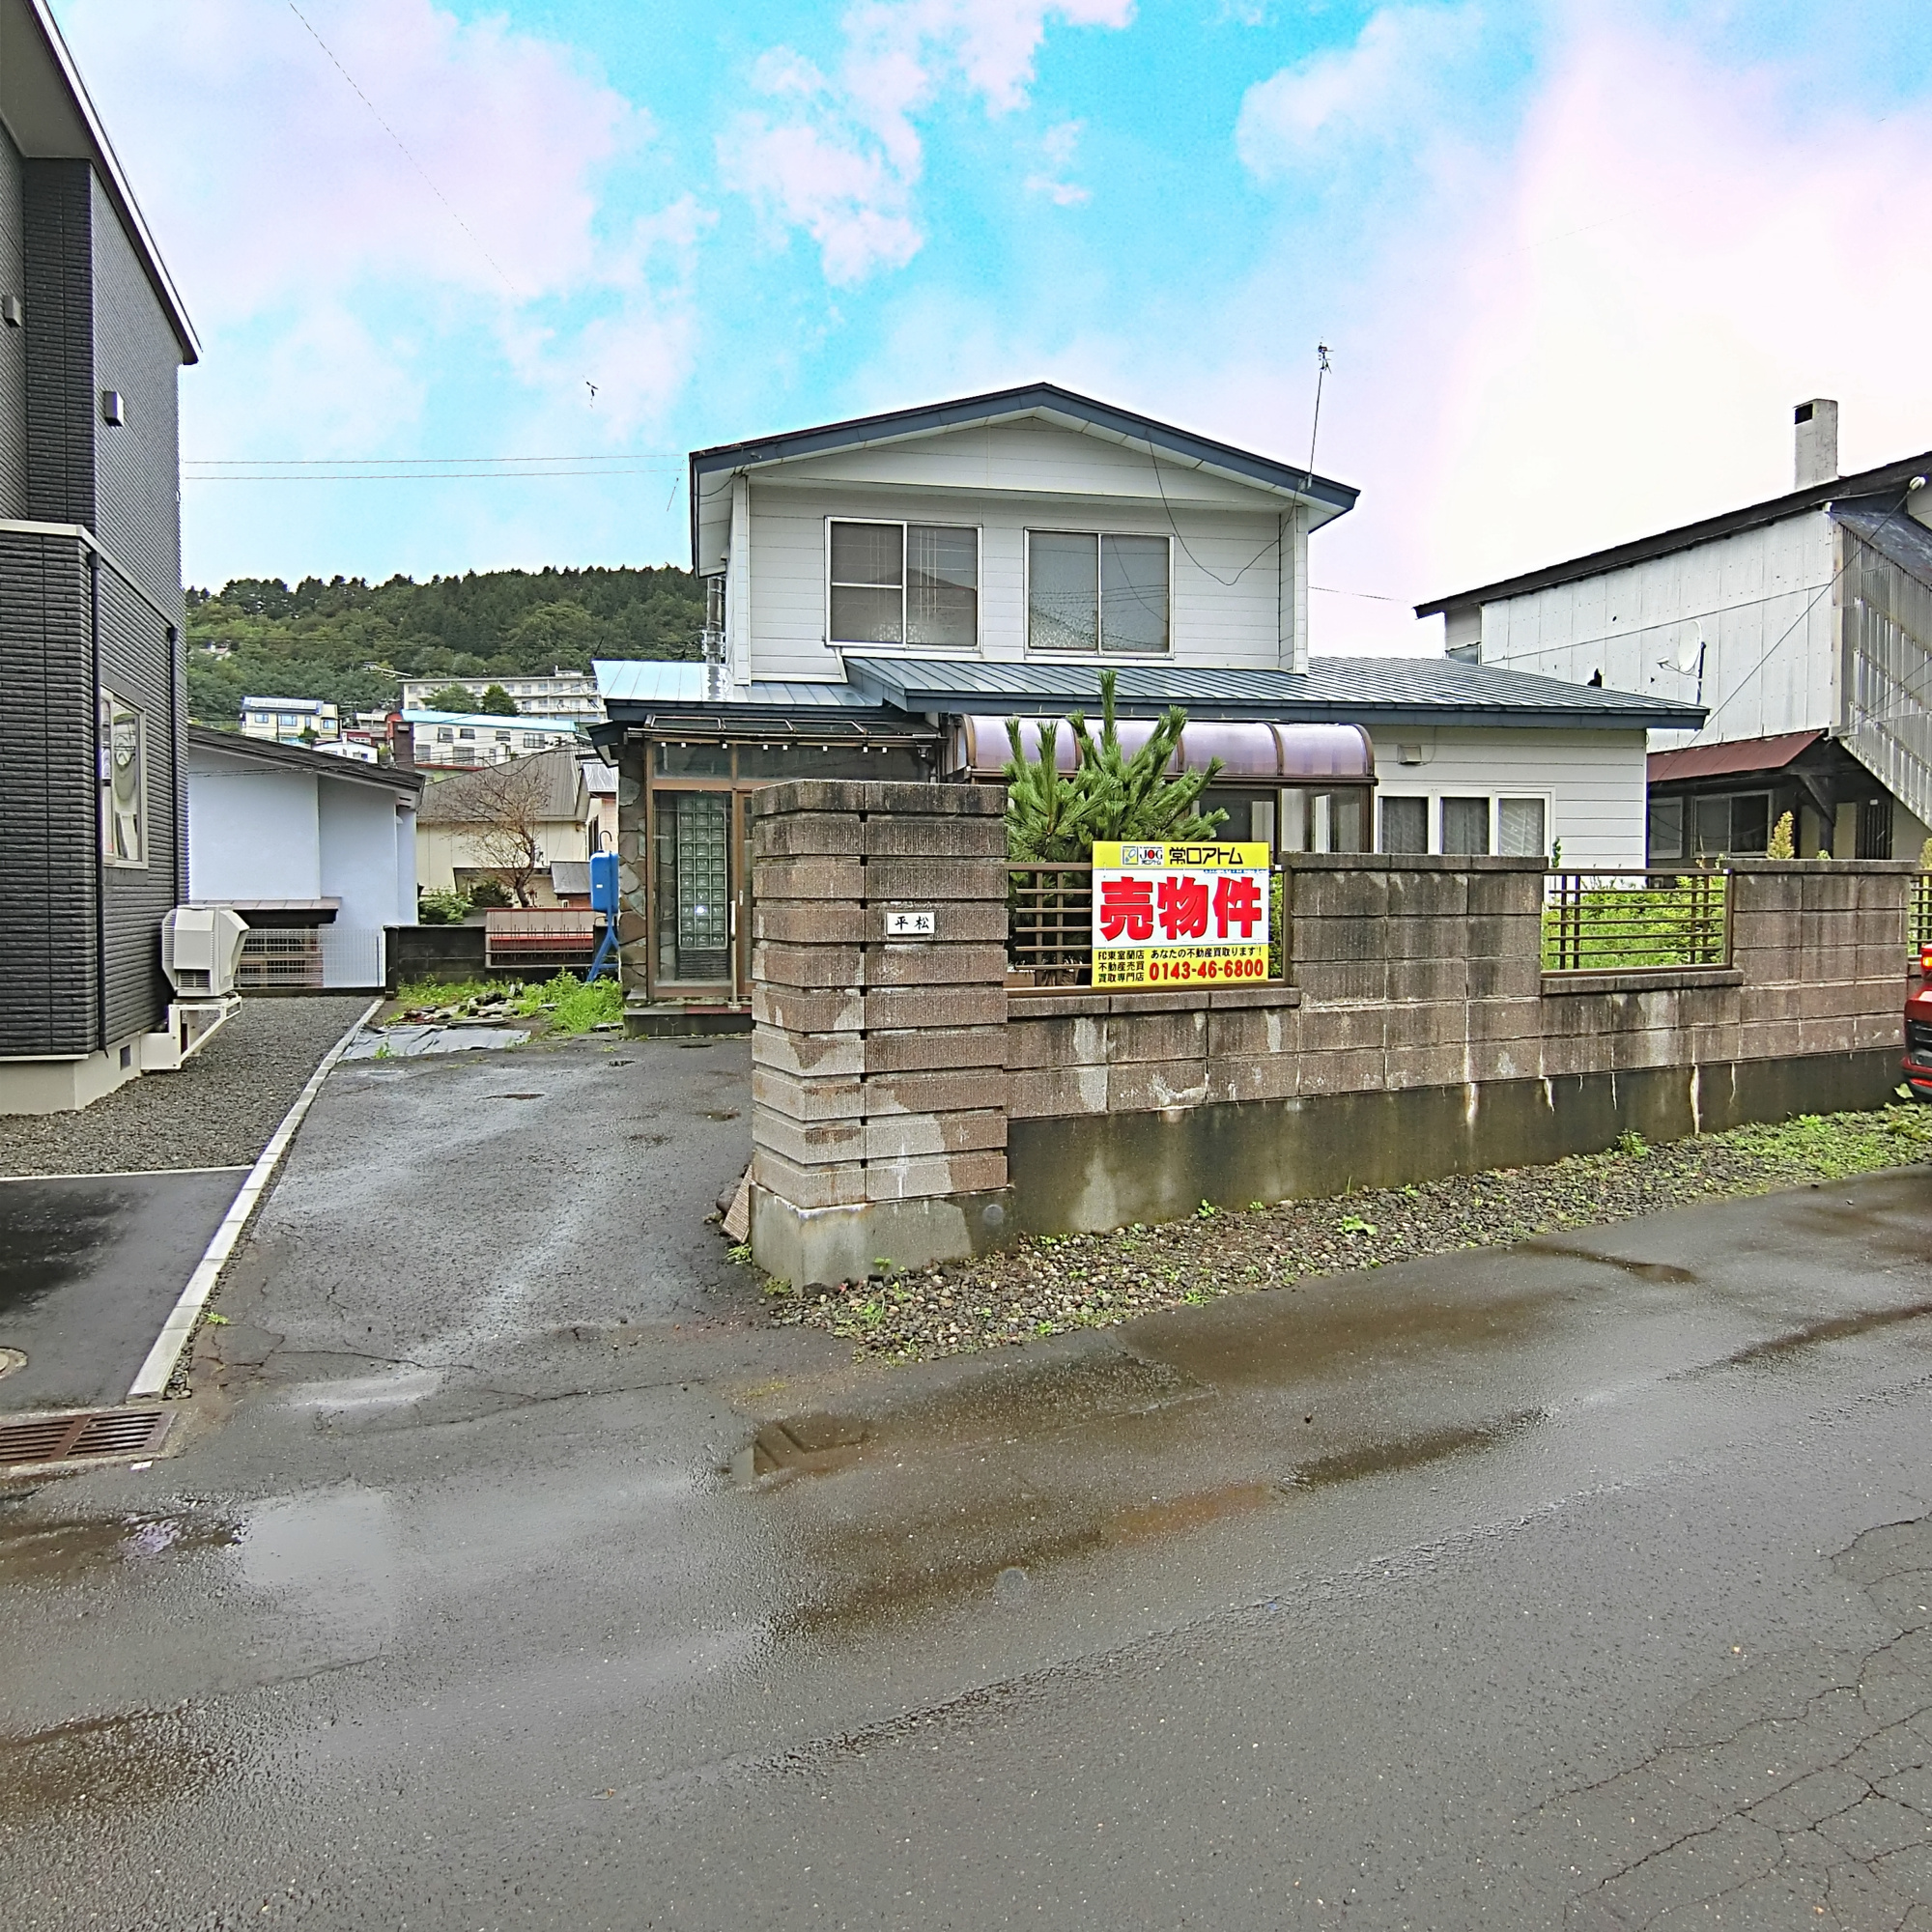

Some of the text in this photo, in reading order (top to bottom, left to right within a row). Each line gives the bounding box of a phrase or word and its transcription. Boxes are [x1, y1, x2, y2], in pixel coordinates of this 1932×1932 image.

[1140, 849, 1163, 860] JOG
[1169, 846, 1243, 865] 常口アトム
[1099, 876, 1262, 941] 売物件
[895, 915, 929, 930] 平松
[1097, 950, 1145, 961] FC東室蘭店
[1097, 961, 1145, 972] 不動産売買
[1150, 958, 1264, 980] 0143-46-6800
[1097, 972, 1145, 983] 買取専門店
